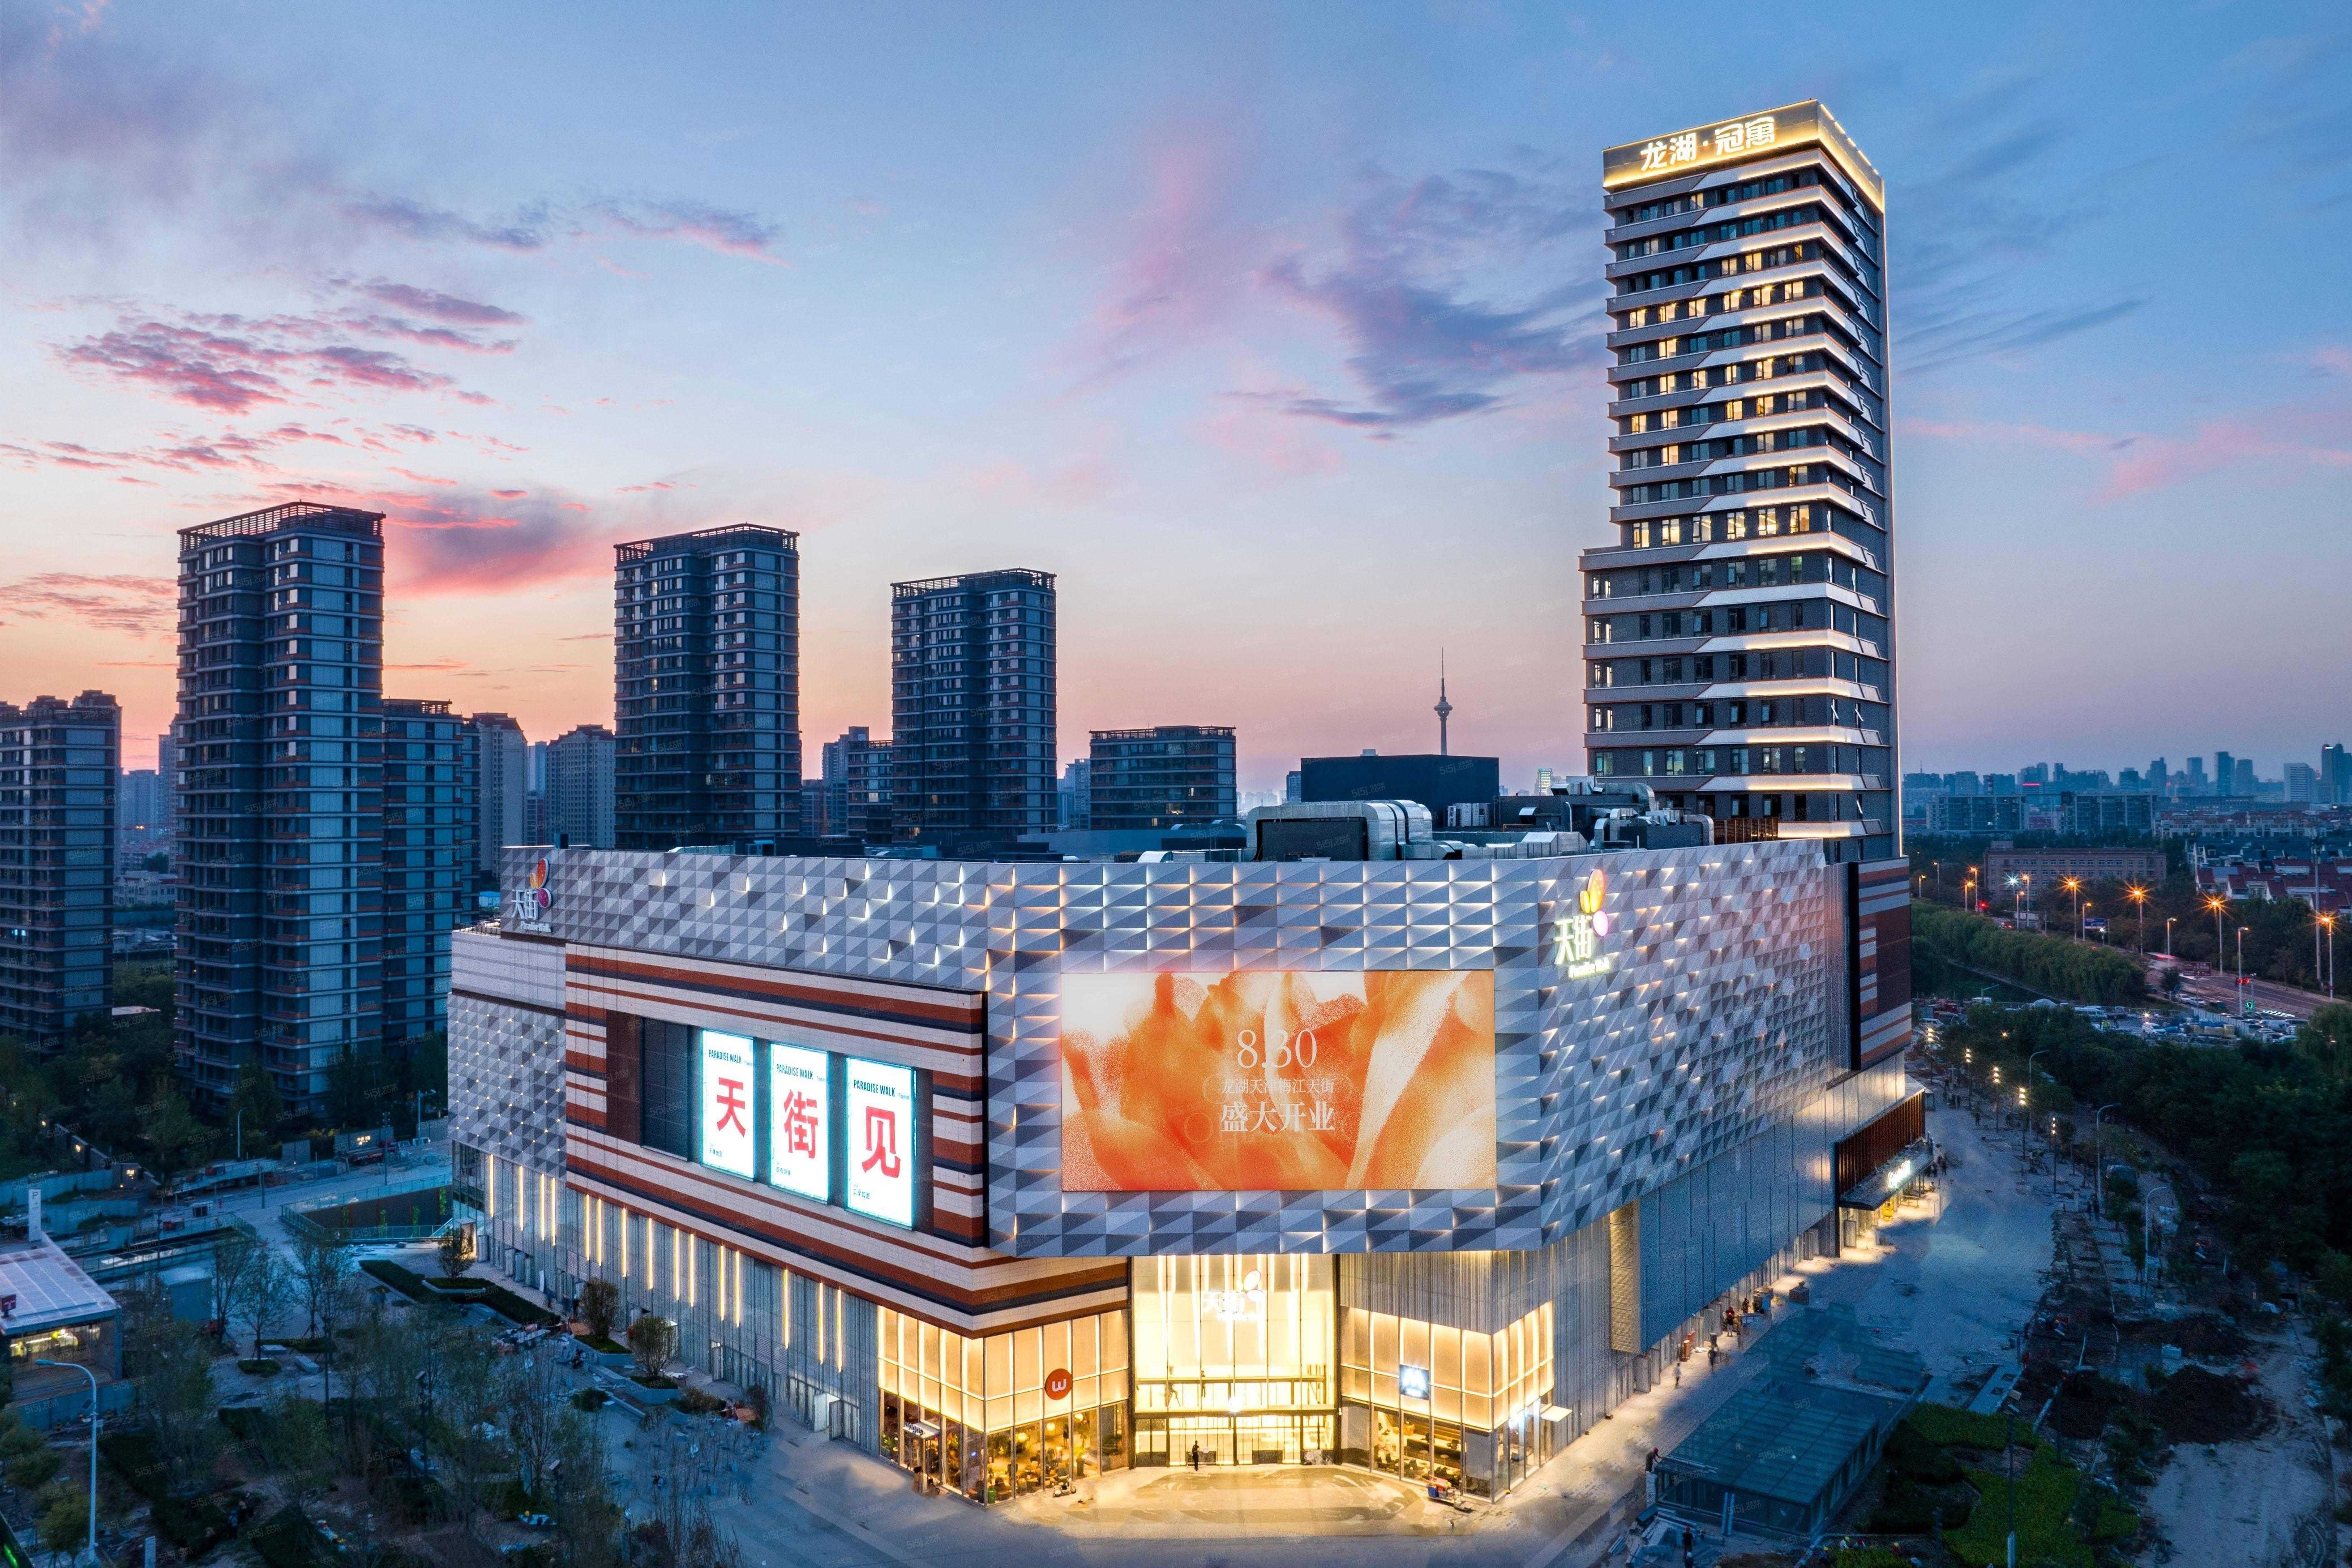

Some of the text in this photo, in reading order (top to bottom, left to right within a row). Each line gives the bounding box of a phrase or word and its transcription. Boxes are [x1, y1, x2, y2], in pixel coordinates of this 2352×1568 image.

[709, 1050, 728, 1061] PARADISE
[730, 1054, 741, 1063] WALK
[1237, 1029, 1317, 1068] 8.30
[776, 1064, 798, 1076] PARADISE
[800, 1068, 813, 1080] WALK
[854, 1080, 878, 1093] PARADISE
[880, 1085, 895, 1097] WALK
[1221, 1078, 1334, 1094] 龙湖天津梅江天街
[716, 1077, 745, 1138] 天
[1221, 1101, 1335, 1132] 盛大开业
[784, 1089, 818, 1159] 街
[861, 1105, 900, 1178] 见
[32, 1191, 38, 1200] P
